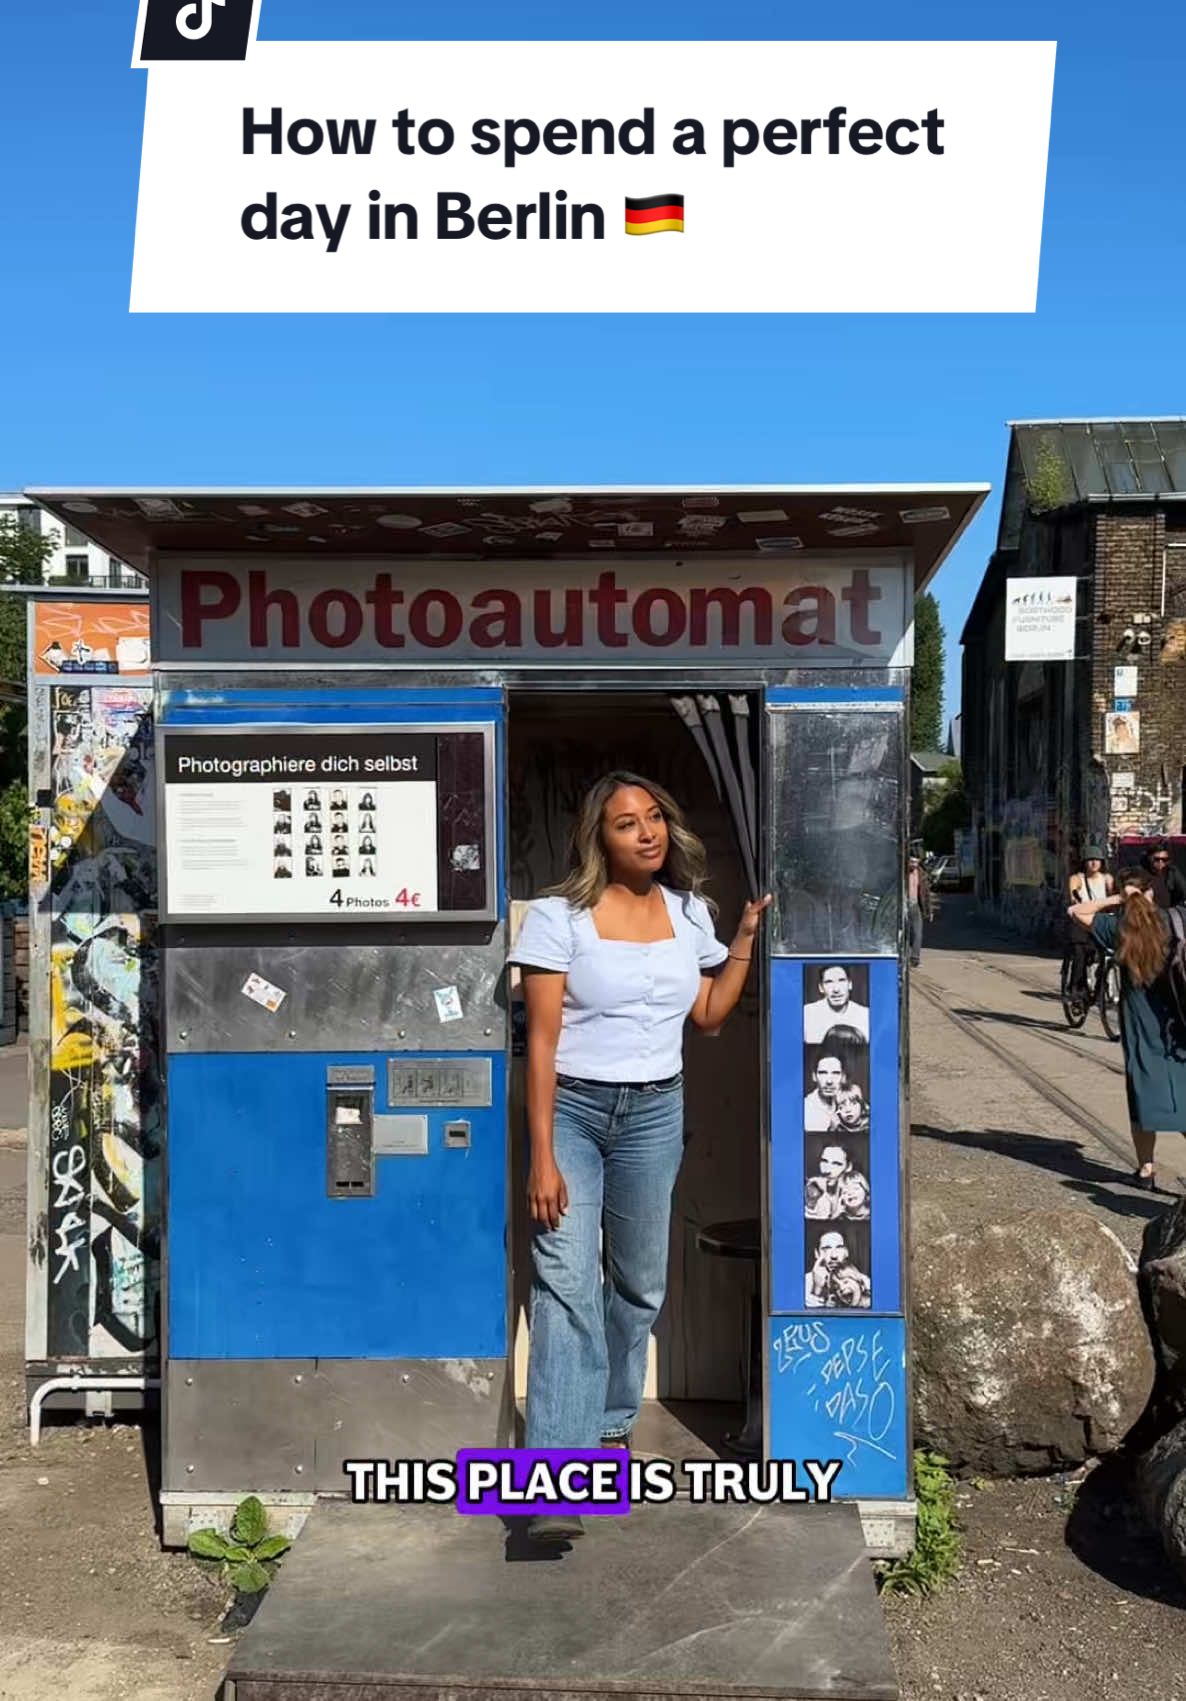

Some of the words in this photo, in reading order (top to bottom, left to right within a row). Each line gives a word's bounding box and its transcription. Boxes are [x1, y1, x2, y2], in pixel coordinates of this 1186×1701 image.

[181, 569, 883, 648] Photoautomat
[178, 756, 316, 777] Photographiere
[321, 756, 359, 773] dich
[364, 755, 418, 772] selbst
[330, 888, 344, 907] 4
[346, 897, 391, 908] Photos
[395, 887, 421, 907] 4€
